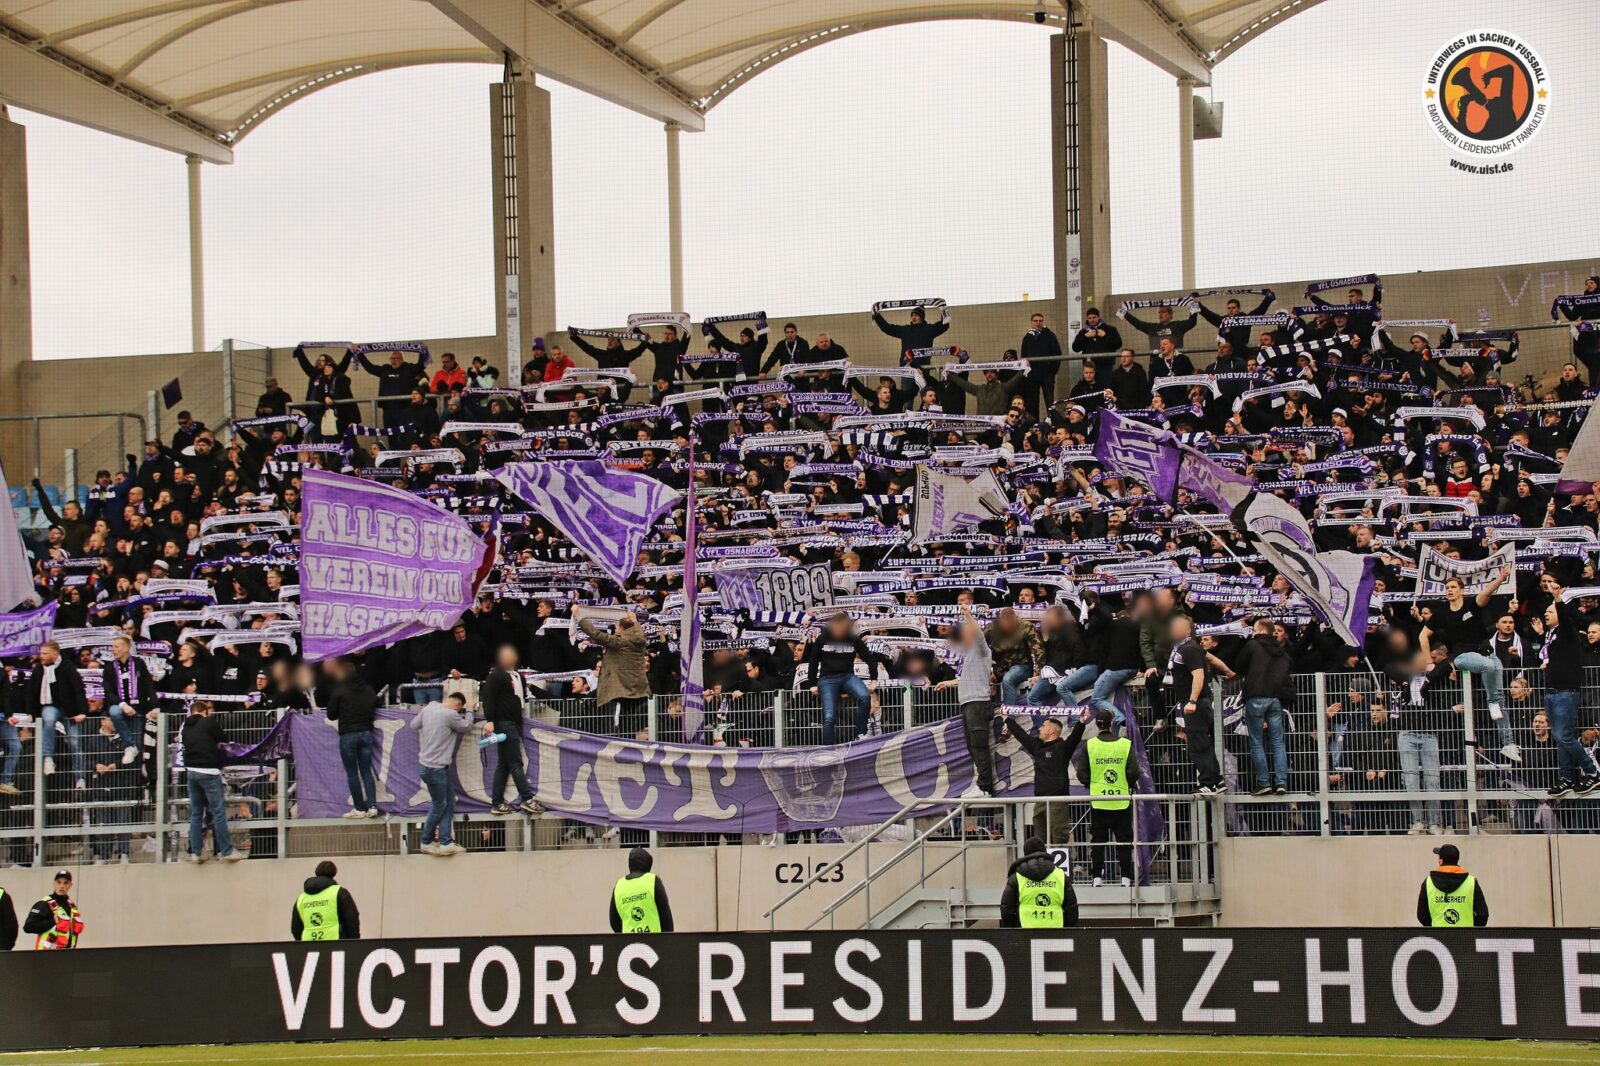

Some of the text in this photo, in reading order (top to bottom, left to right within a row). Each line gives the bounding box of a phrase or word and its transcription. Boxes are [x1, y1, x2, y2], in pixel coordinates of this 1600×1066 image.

[304, 501, 477, 563] ALLES FÜR
[304, 554, 464, 606] VEREIN UND
[756, 566, 832, 611] 1899
[1100, 580, 1144, 594] REBELLION
[1191, 584, 1233, 593] REBELLION
[1200, 594, 1243, 602] REBELLION
[1002, 706, 1083, 715] VIOLET CREW
[1095, 757, 1124, 765] SICHERHEIT
[775, 862, 844, 883] C2 C3
[1026, 880, 1057, 889] SICHERHEIT
[622, 892, 647, 904] SICHERHEIT
[303, 899, 329, 909] SICHERHEIT
[311, 930, 325, 941] 92
[271, 943, 661, 1030] VICTOR'S
